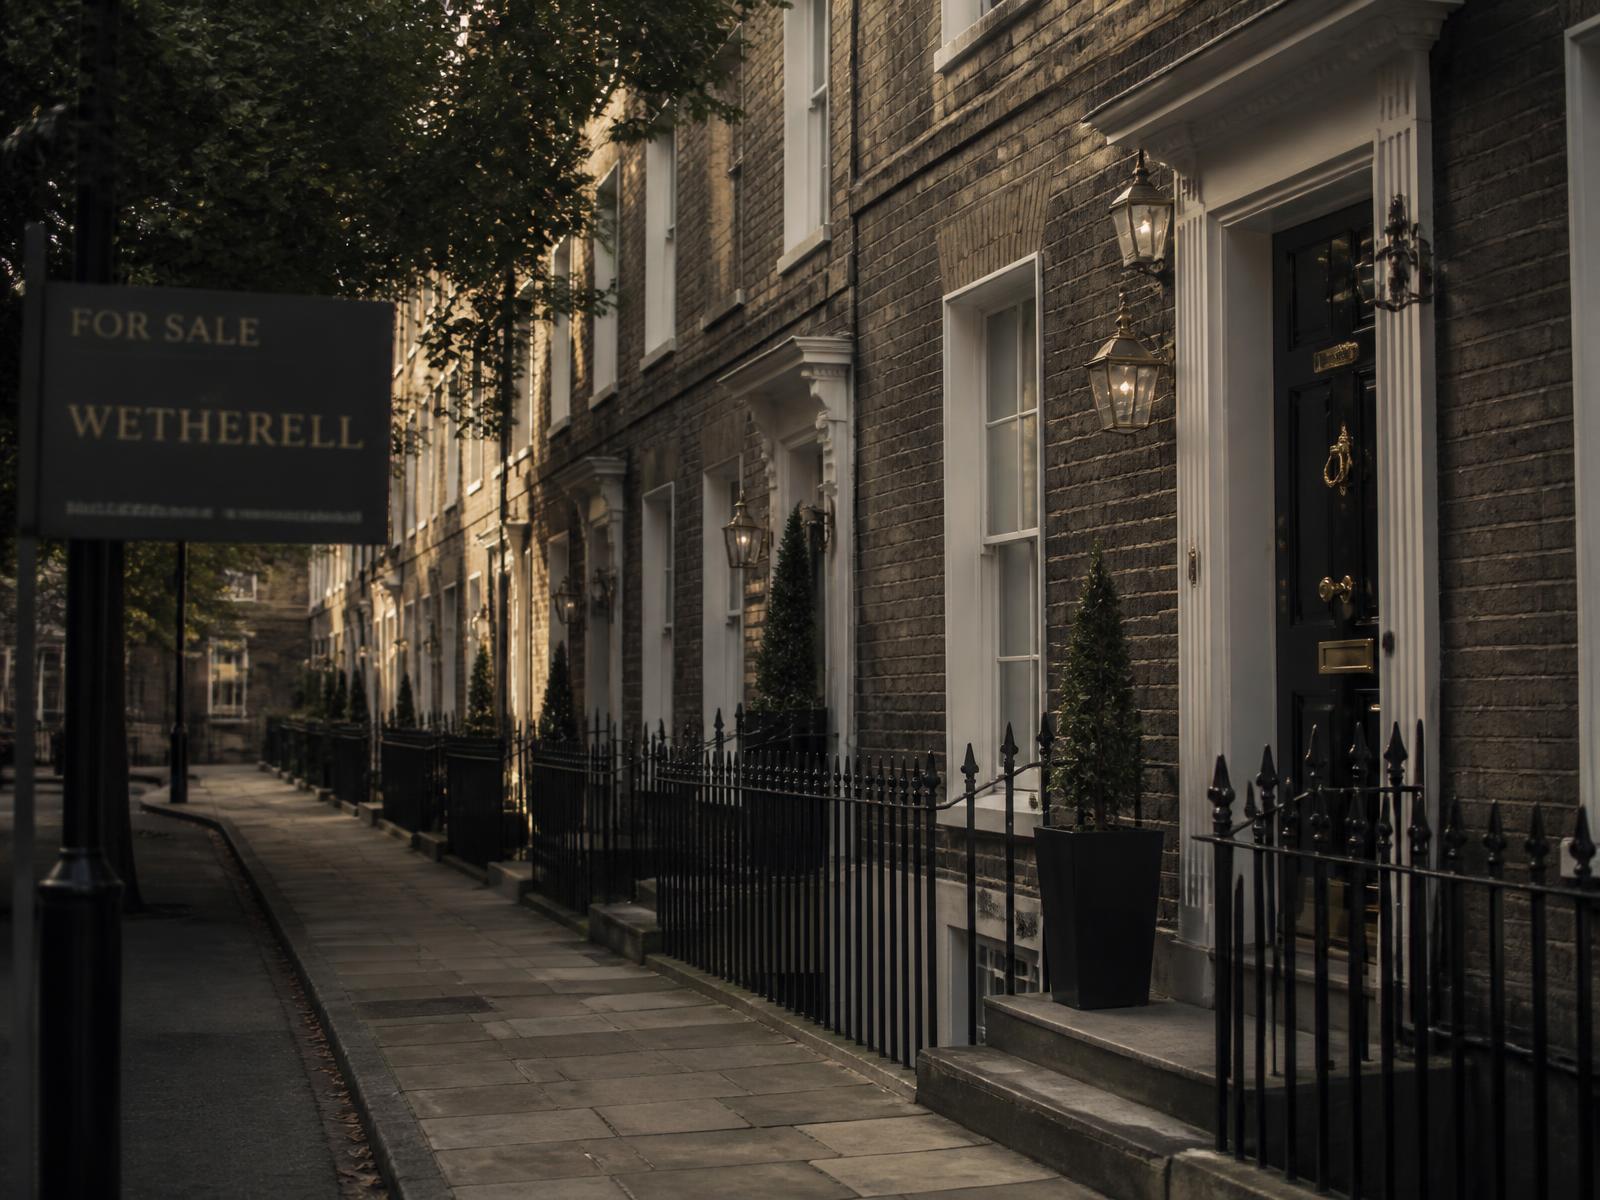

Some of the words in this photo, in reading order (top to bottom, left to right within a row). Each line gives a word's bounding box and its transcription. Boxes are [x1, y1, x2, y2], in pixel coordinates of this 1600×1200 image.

[71, 308, 150, 340] FOR
[165, 313, 260, 347] SALE
[68, 403, 364, 449] WETHERELL
